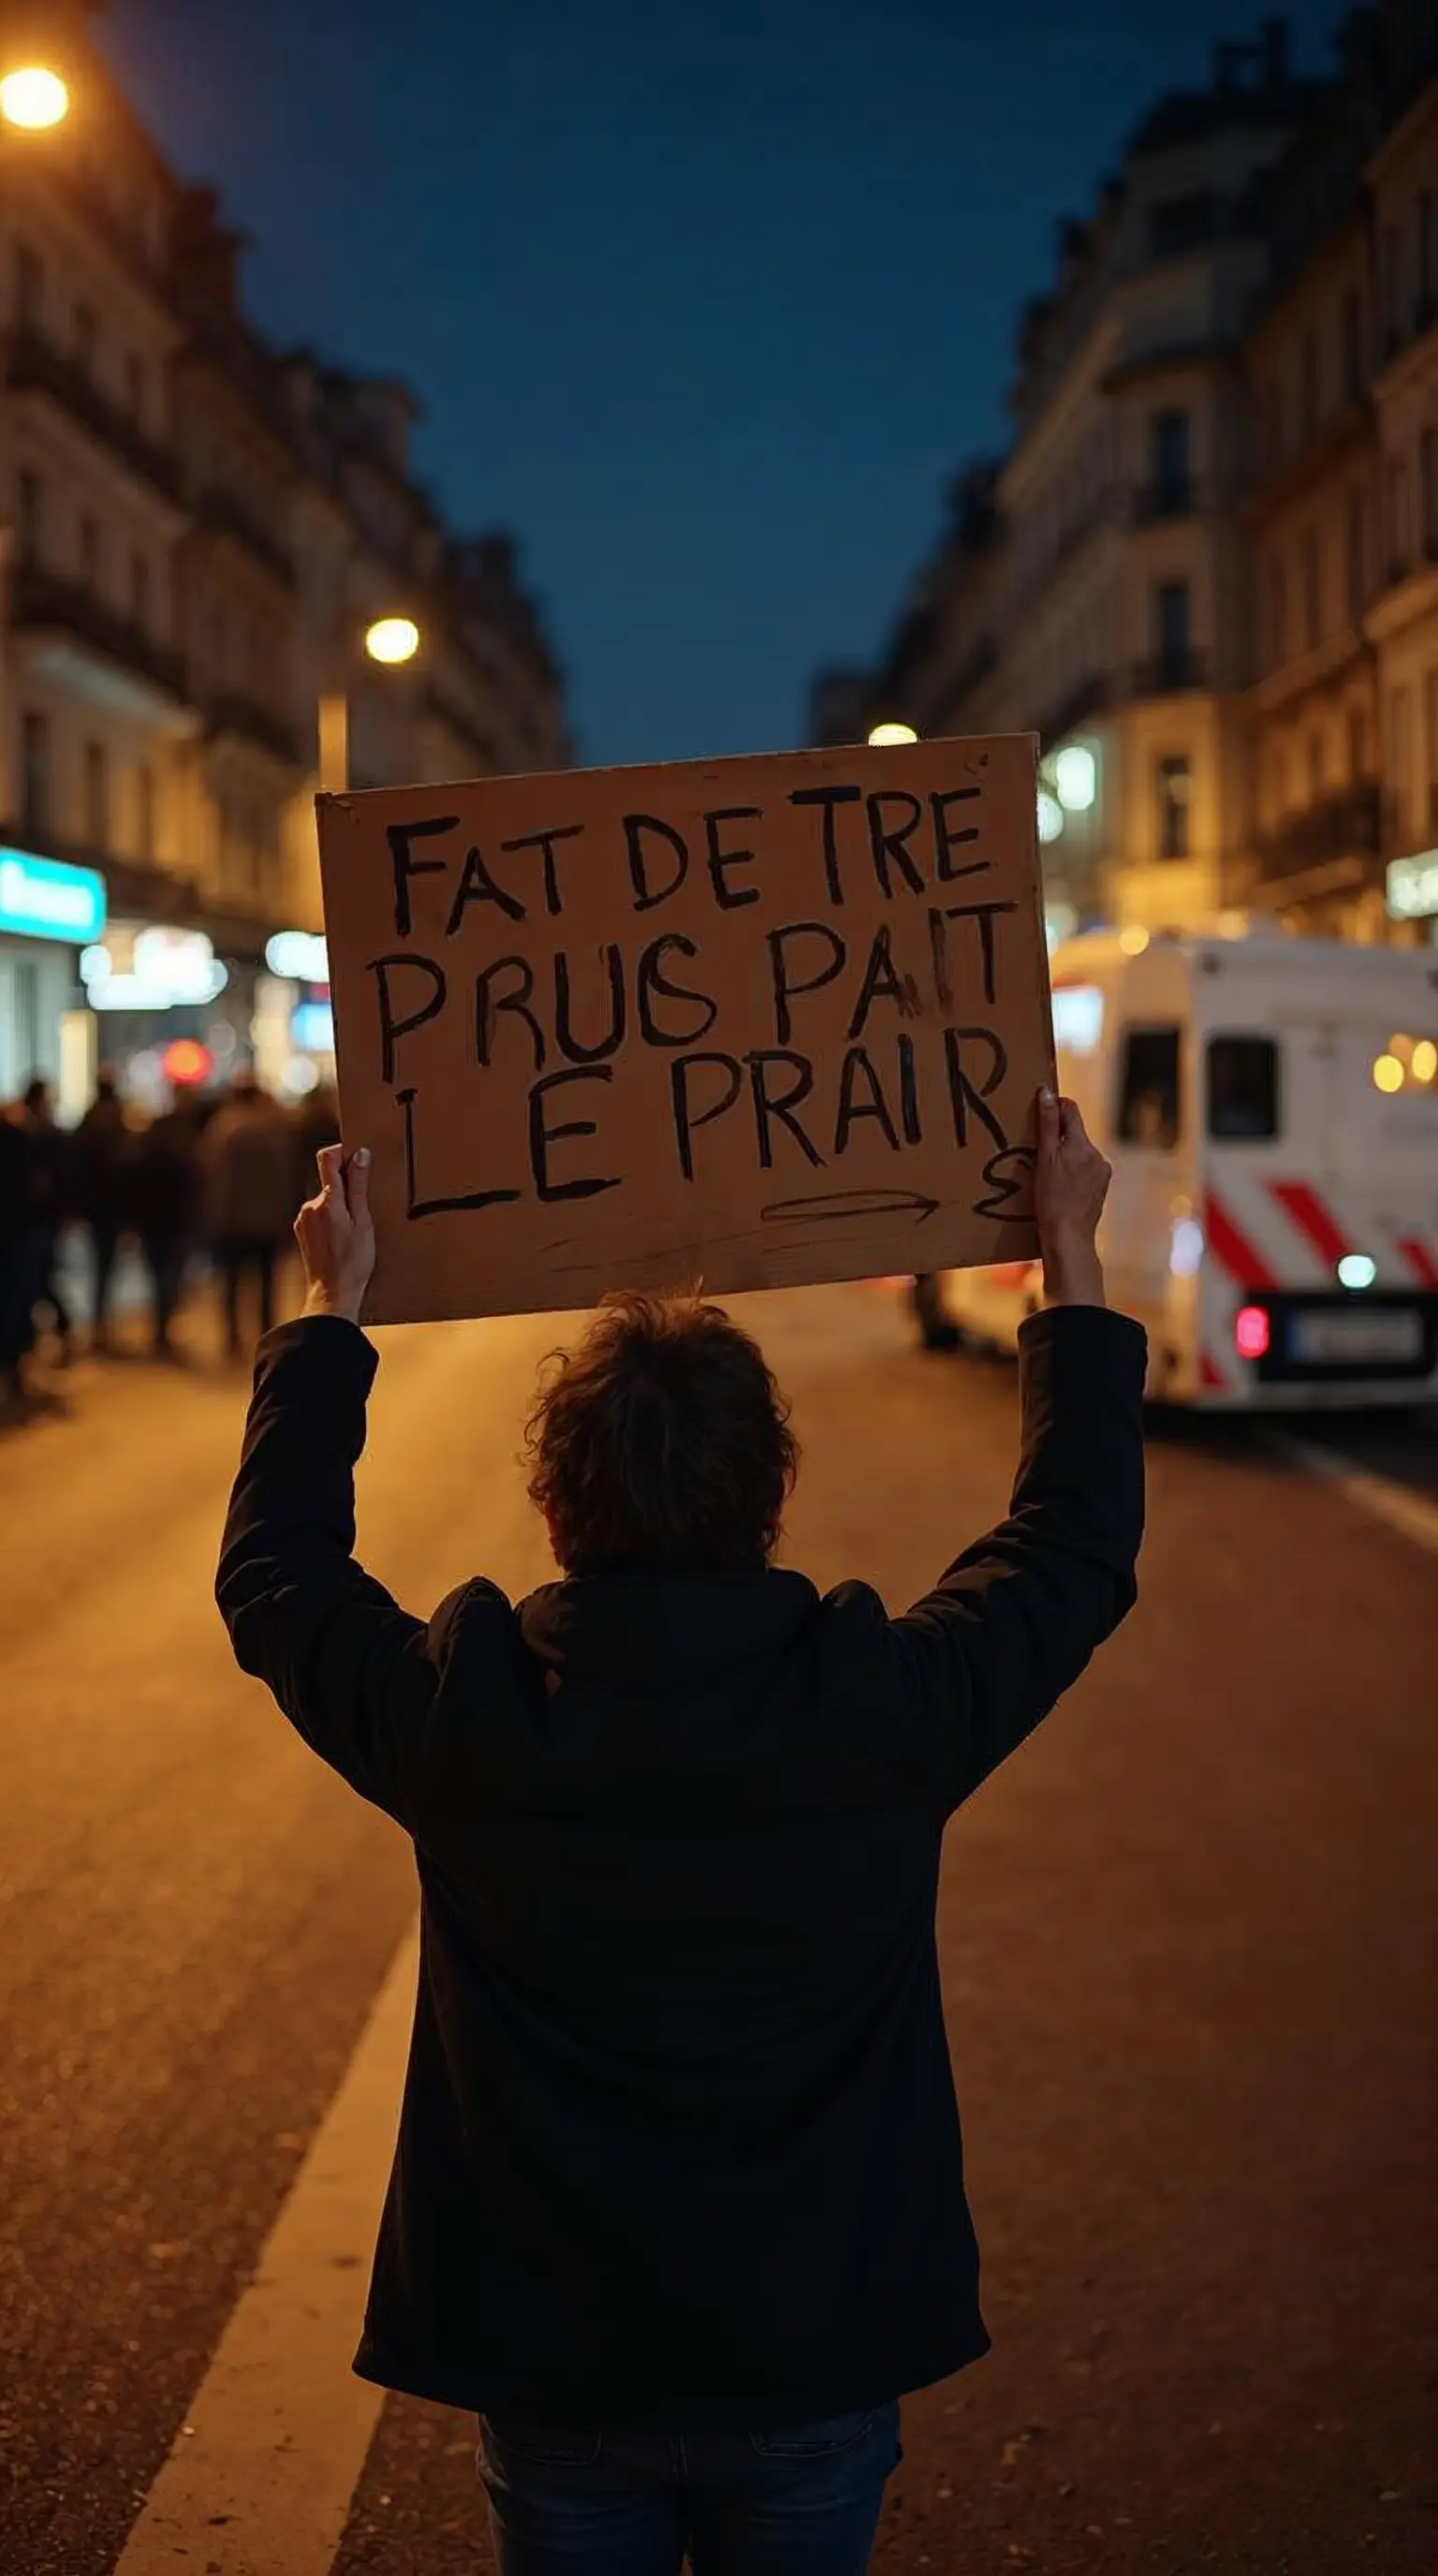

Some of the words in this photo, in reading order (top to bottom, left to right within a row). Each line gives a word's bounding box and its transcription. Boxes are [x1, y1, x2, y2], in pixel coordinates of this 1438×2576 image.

[387, 816, 584, 938] FAT
[395, 1065, 623, 1221] LE
[670, 1027, 1010, 1181] PRAIR
